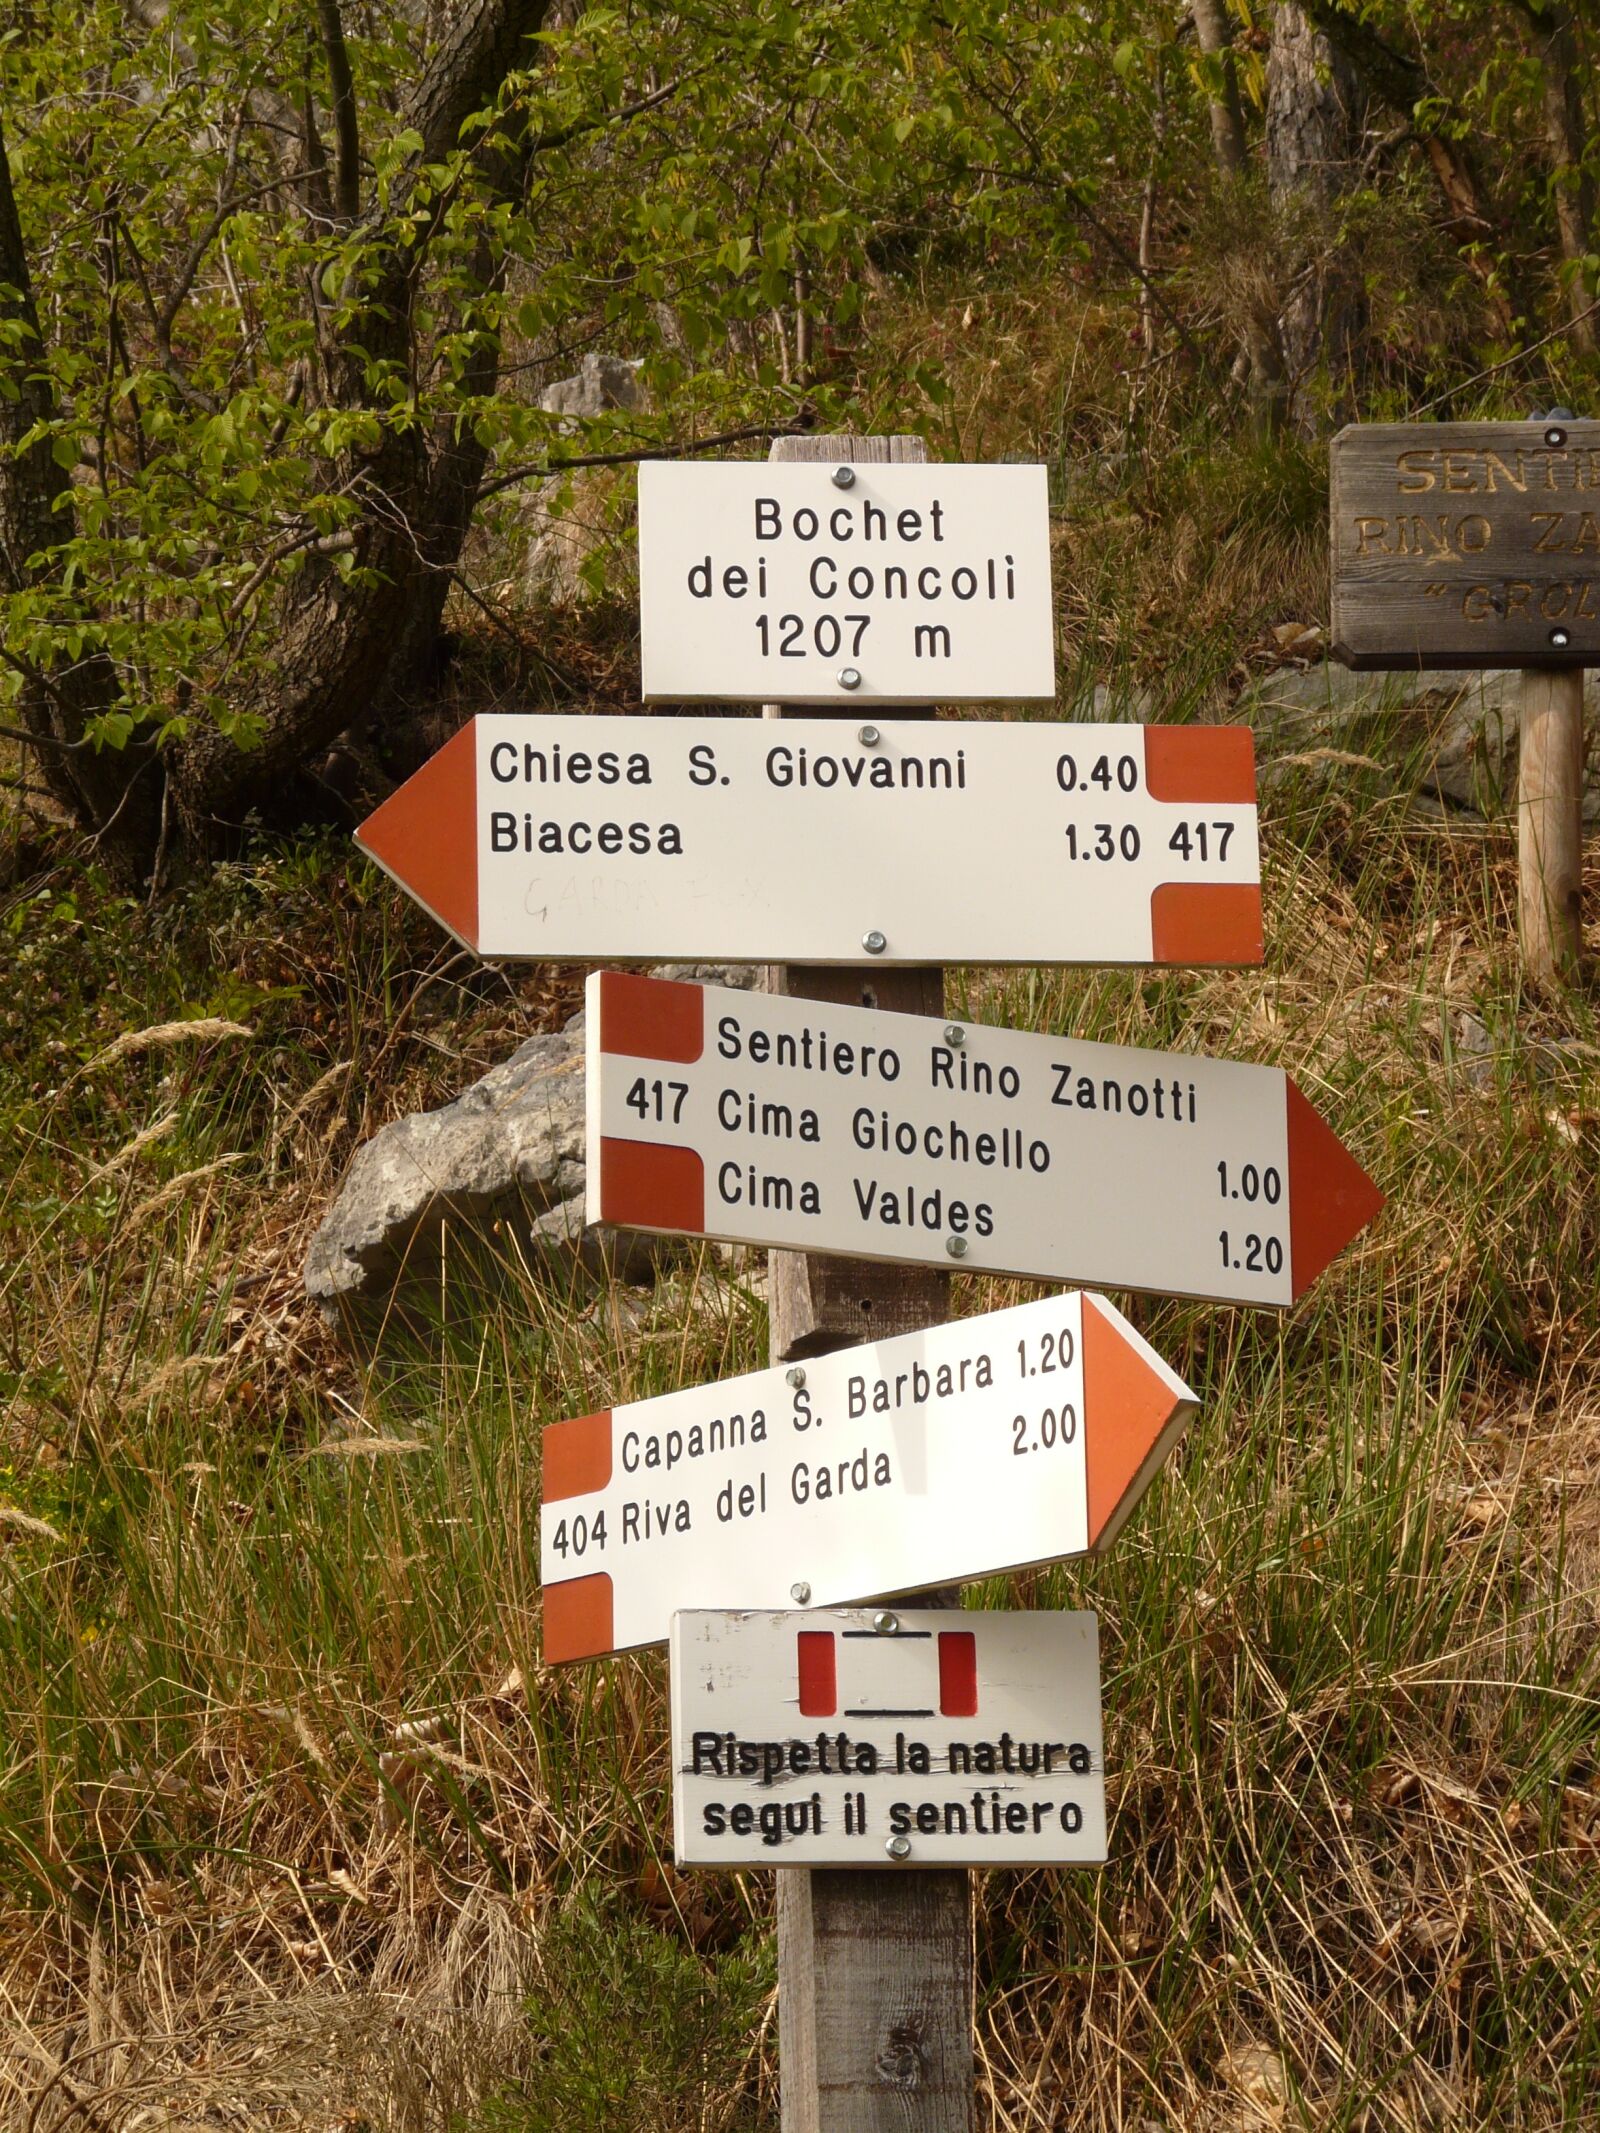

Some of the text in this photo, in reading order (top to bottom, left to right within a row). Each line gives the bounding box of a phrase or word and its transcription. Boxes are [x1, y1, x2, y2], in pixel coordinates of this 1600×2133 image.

[755, 498, 944, 542] Bochet
[1353, 515, 1492, 556] RINO
[687, 554, 1015, 601] dei Concolì
[755, 614, 951, 658] 1207 m
[490, 741, 1138, 793] Chiesa S. Giovanni 0.40
[491, 811, 1141, 862] Biacesa 1.30
[1168, 821, 1235, 862] 417
[717, 1016, 1196, 1123] Sentiero Rino Zanotti
[626, 1077, 689, 1124] 417
[718, 1089, 1281, 1205] Cima Giochello 1.00
[718, 1161, 1283, 1275] Cima Valdes 1.20
[622, 1328, 1074, 1473] Capanna S. Barbara 1.20
[622, 1403, 1076, 1545] Riva del Garda 2.00
[552, 1510, 608, 1559] 404
[692, 1732, 1090, 1785] Rispetta la natura
[703, 1792, 1083, 1846] segui il sentiero
